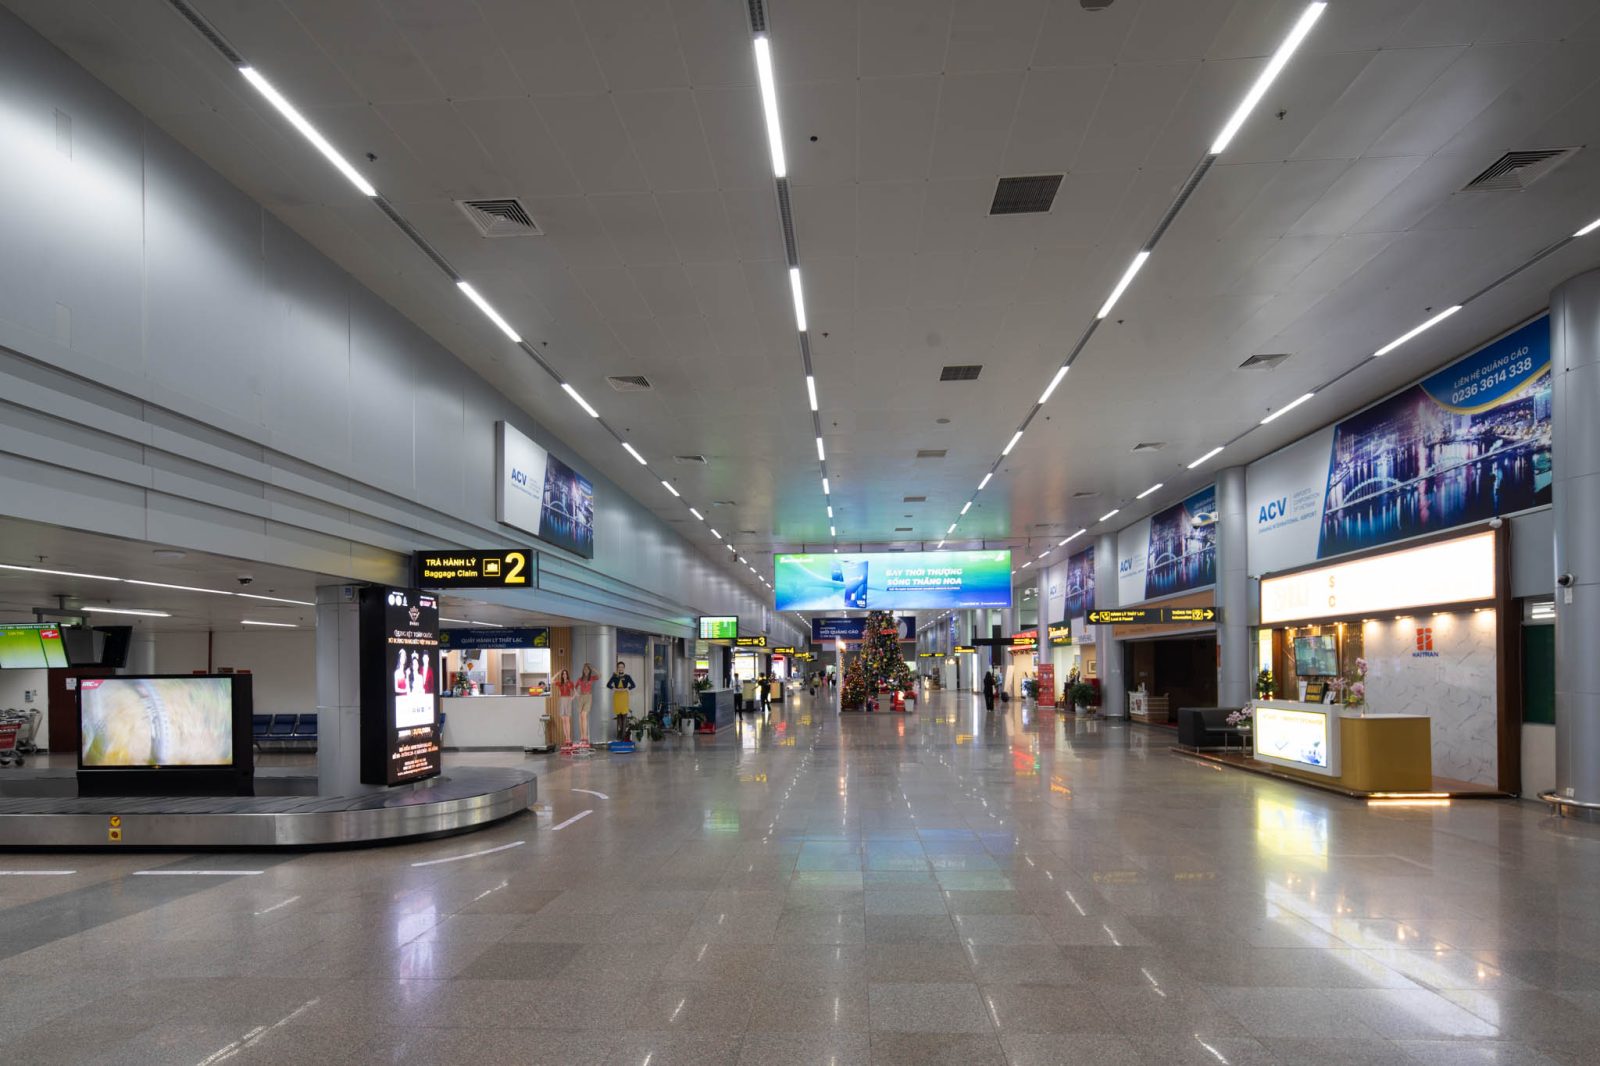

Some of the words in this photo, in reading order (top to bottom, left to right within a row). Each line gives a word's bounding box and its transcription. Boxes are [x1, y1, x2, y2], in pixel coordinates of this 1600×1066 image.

[1454, 375, 1470, 389] LIÊN
[1470, 369, 1480, 381] HỆ
[1481, 355, 1509, 376] QUẢNG
[1510, 346, 1529, 361] CÁO
[1452, 383, 1478, 404] 0236
[1479, 369, 1507, 392] 3614
[1508, 357, 1532, 378] 338
[511, 467, 527, 486] ACV
[1258, 496, 1287, 524] ACV
[426, 557, 441, 567] TRẢ
[443, 557, 464, 567] HÀNH
[466, 557, 476, 567] LÝ
[504, 552, 525, 584] 2
[1120, 556, 1133, 573] ACV
[424, 570, 456, 578] Baggage
[943, 577, 962, 585] HOA
[758, 637, 766, 647] 3
